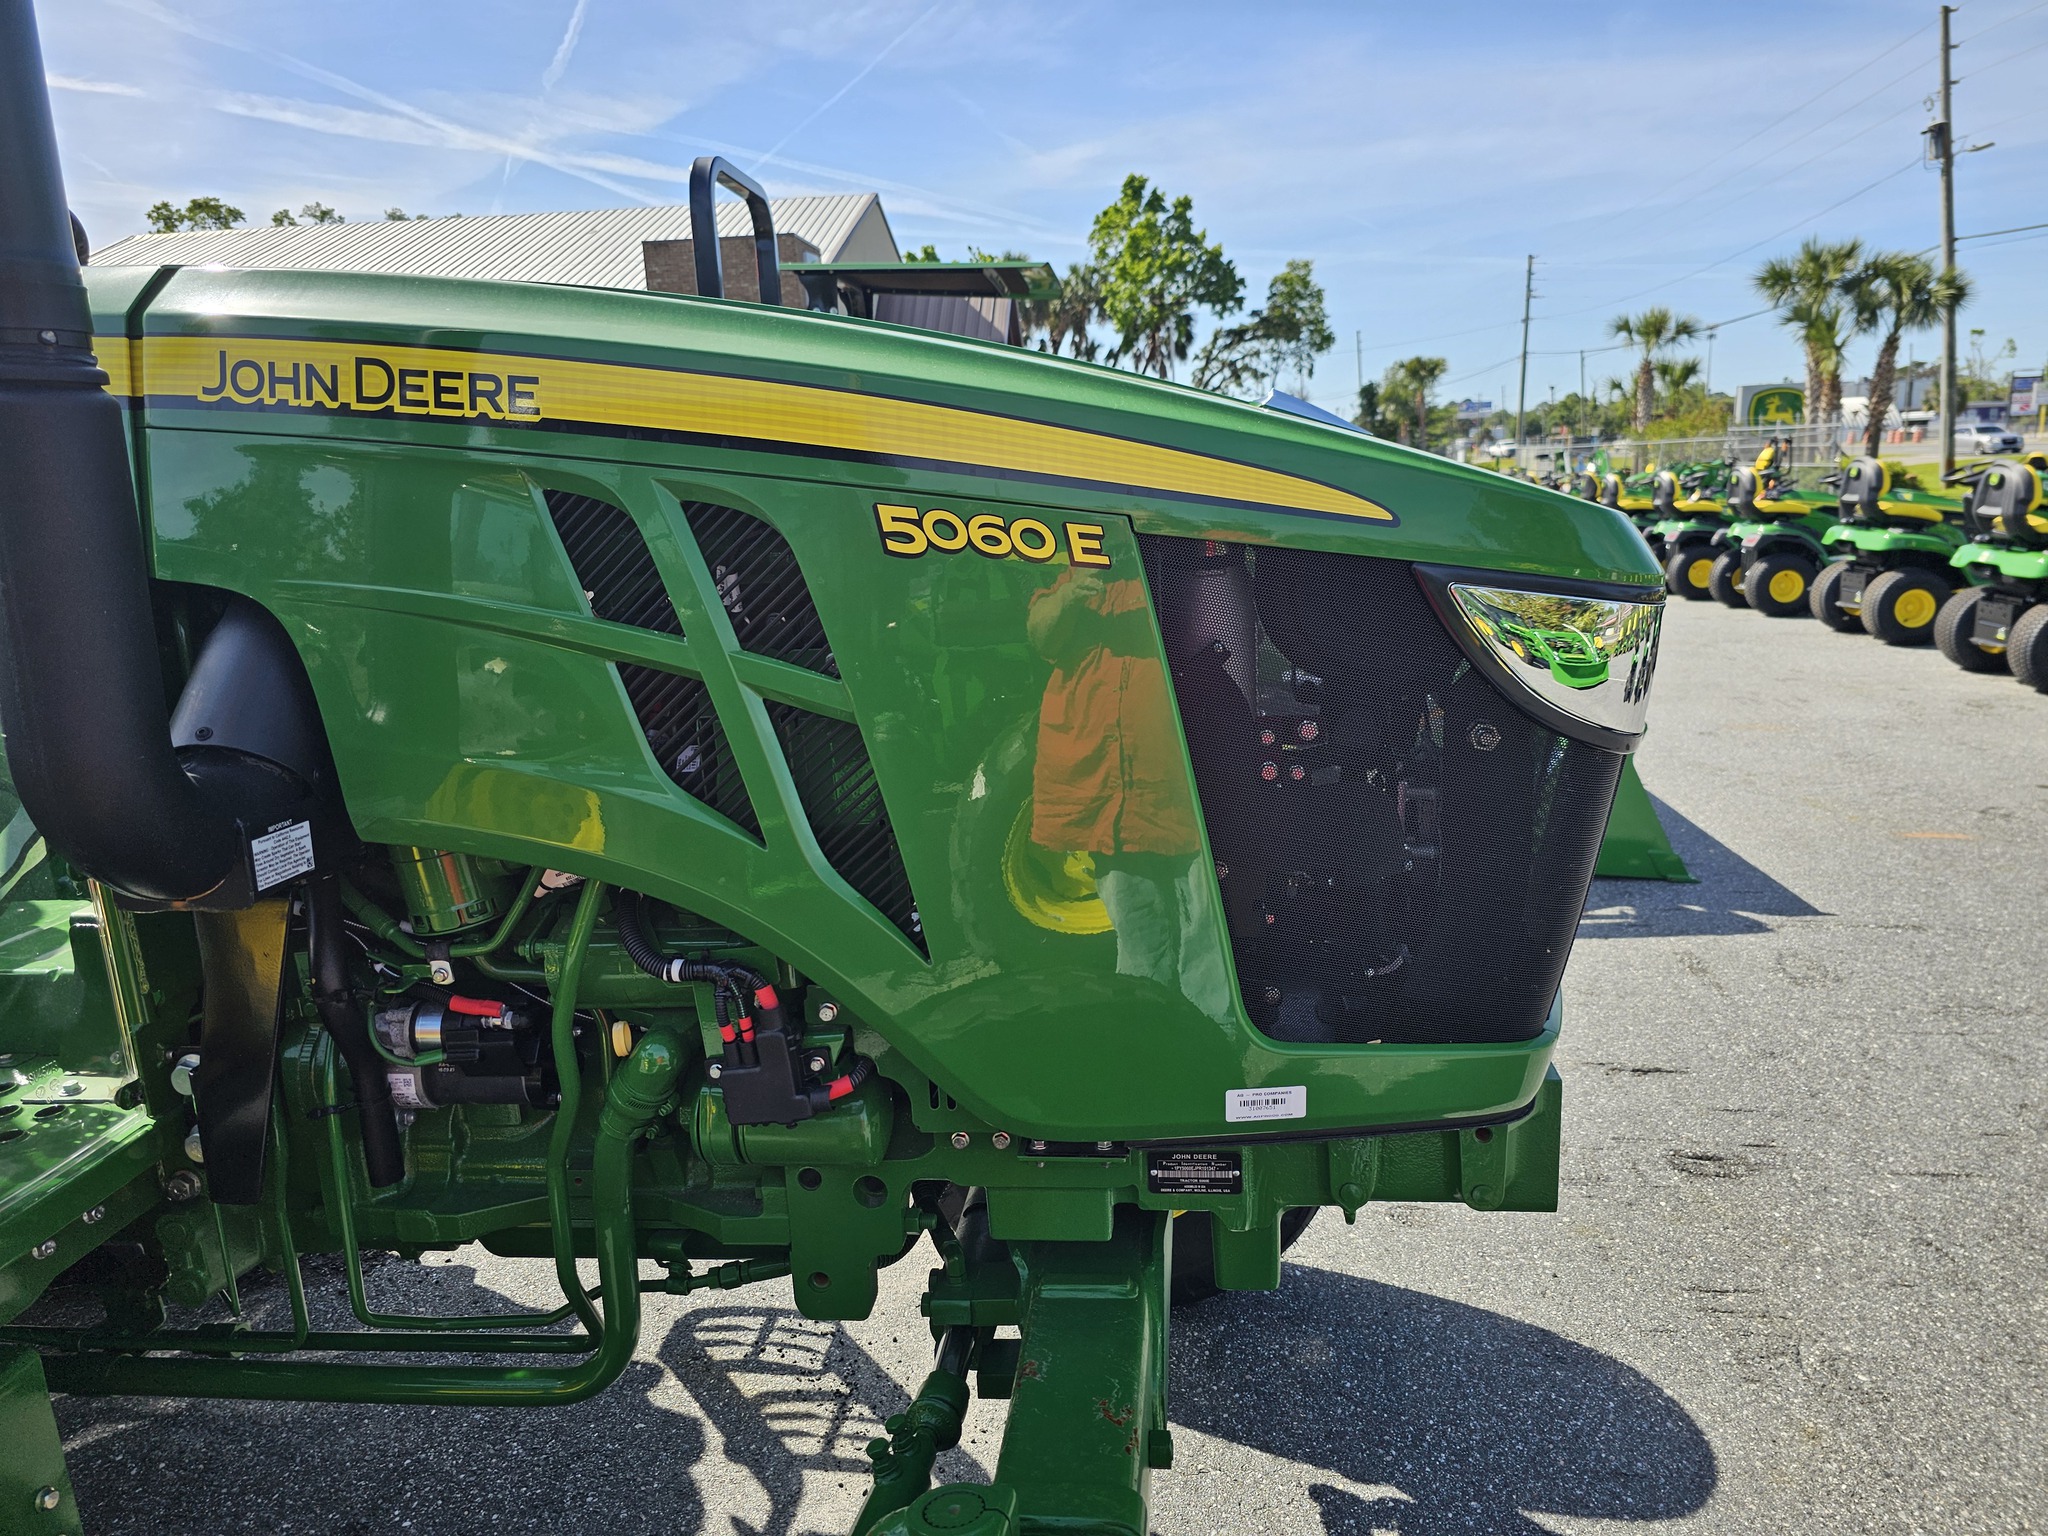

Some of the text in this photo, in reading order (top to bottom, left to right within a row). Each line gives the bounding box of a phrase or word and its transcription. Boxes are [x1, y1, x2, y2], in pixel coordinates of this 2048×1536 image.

[873, 503, 1112, 570] 5060 E
[268, 819, 293, 832] IMPORTANT
